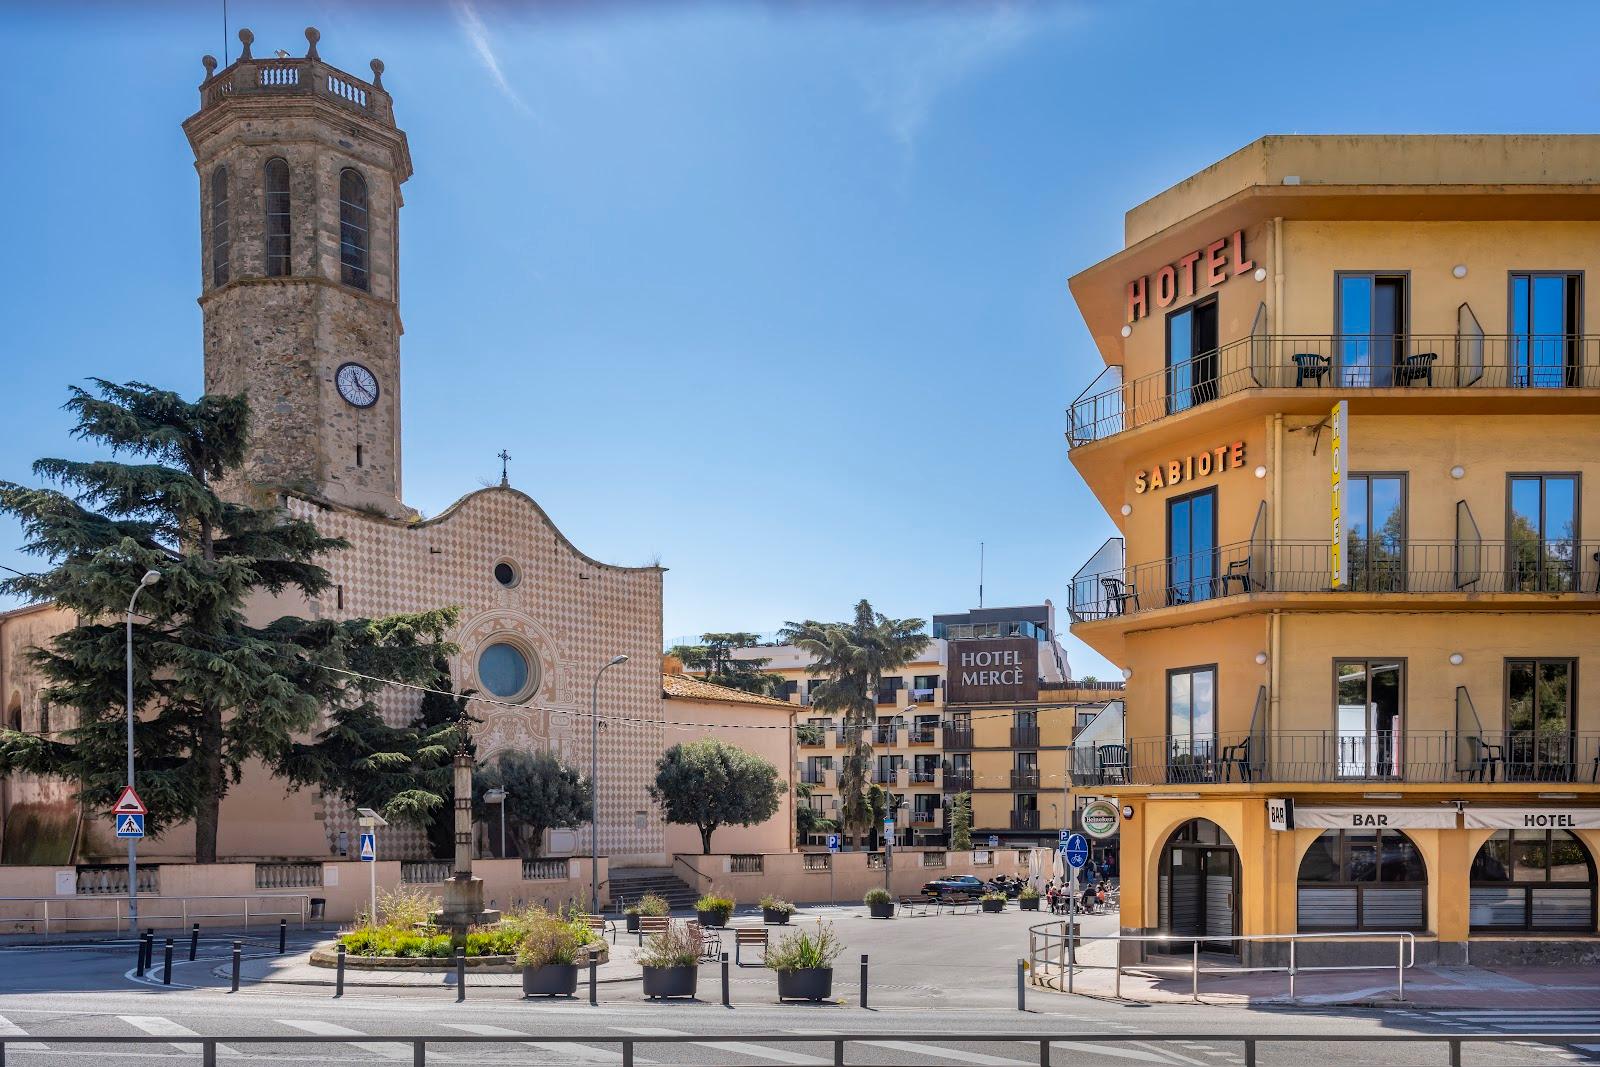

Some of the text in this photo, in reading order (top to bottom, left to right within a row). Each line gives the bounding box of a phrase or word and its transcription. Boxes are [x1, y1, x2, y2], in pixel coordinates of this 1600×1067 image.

[1127, 230, 1254, 323] HOTEL
[1135, 441, 1244, 494] SABIOTE
[1332, 409, 1340, 581] HOTEL
[961, 650, 1023, 667] HOTEL
[961, 666, 1023, 686] MERCÈ
[1270, 806, 1285, 824] BAR
[1352, 814, 1388, 826] BAR
[1524, 814, 1576, 827] HOTEL
[829, 834, 836, 848] P
[1060, 831, 1067, 840] P
